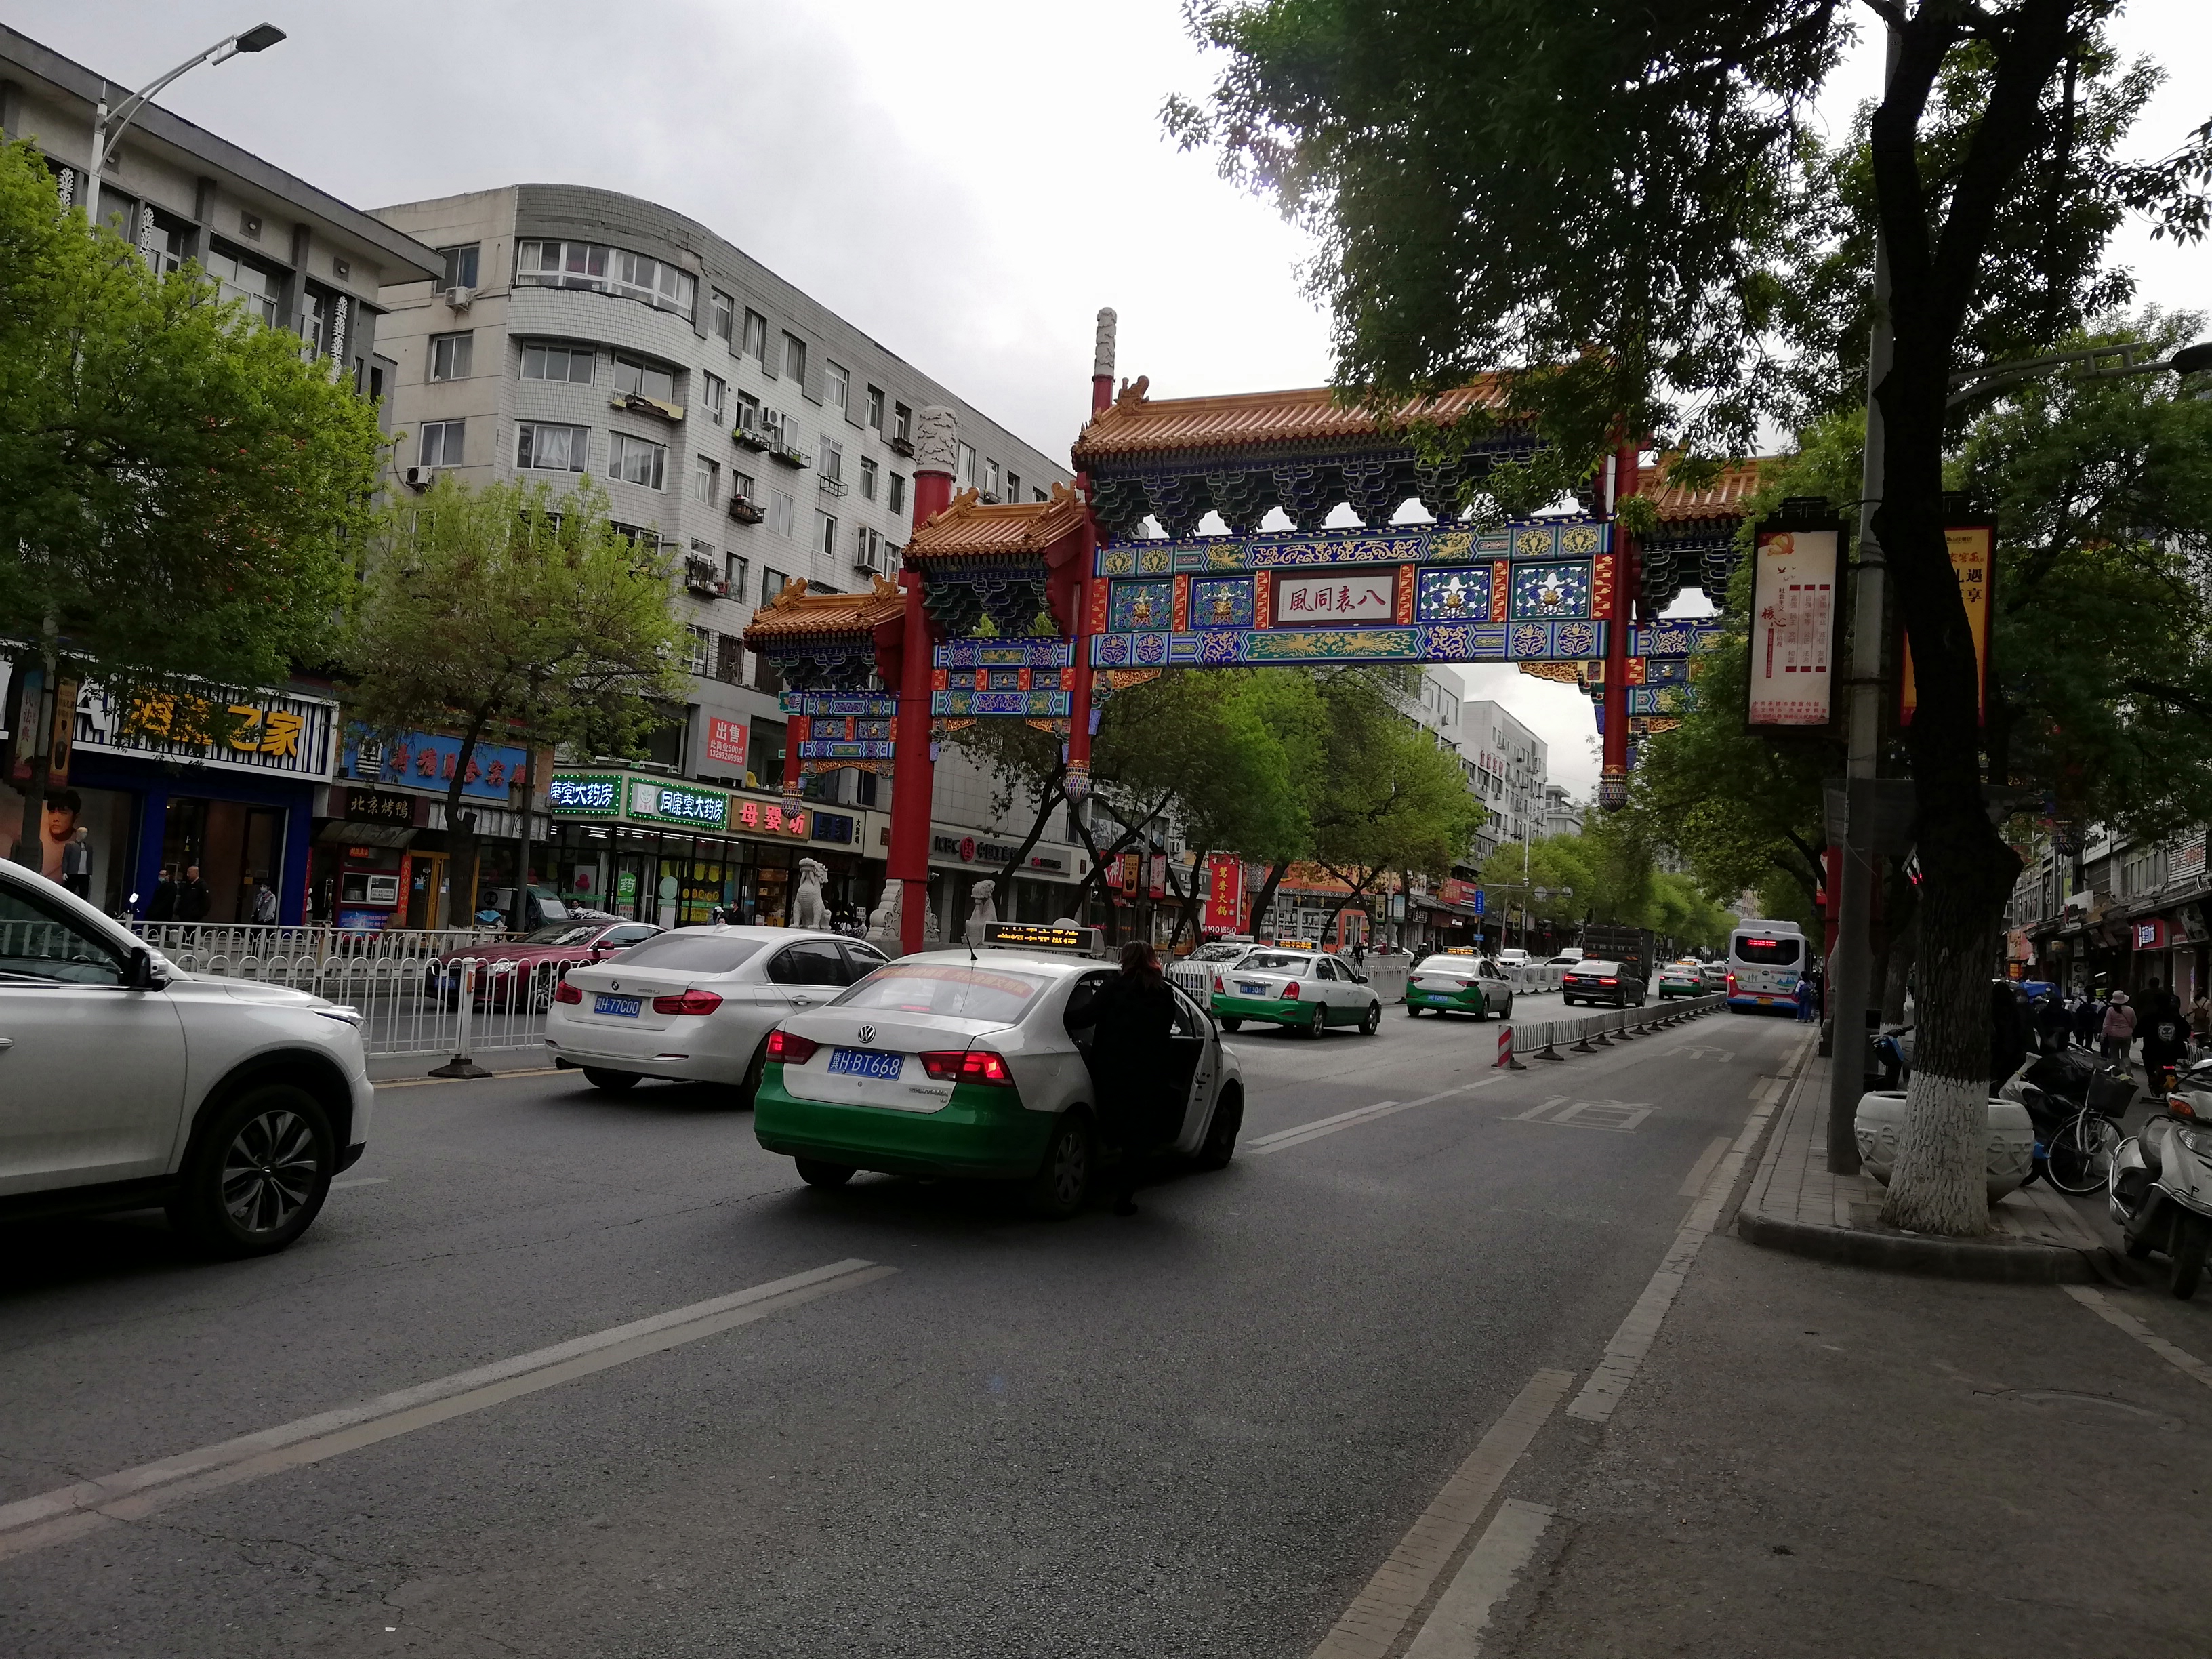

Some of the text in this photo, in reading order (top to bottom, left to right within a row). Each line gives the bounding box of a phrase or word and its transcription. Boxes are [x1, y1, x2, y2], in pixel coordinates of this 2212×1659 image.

[1762, 607, 1787, 628] 核心
[716, 722, 741, 743] 出售
[709, 749, 743, 763] 13293209999
[660, 790, 724, 822] 同康堂大药房
[739, 802, 805, 834] 母婴坊
[935, 835, 960, 854] ICBC
[619, 877, 636, 893] 药
[909, 1087, 949, 1097] SANTANA
